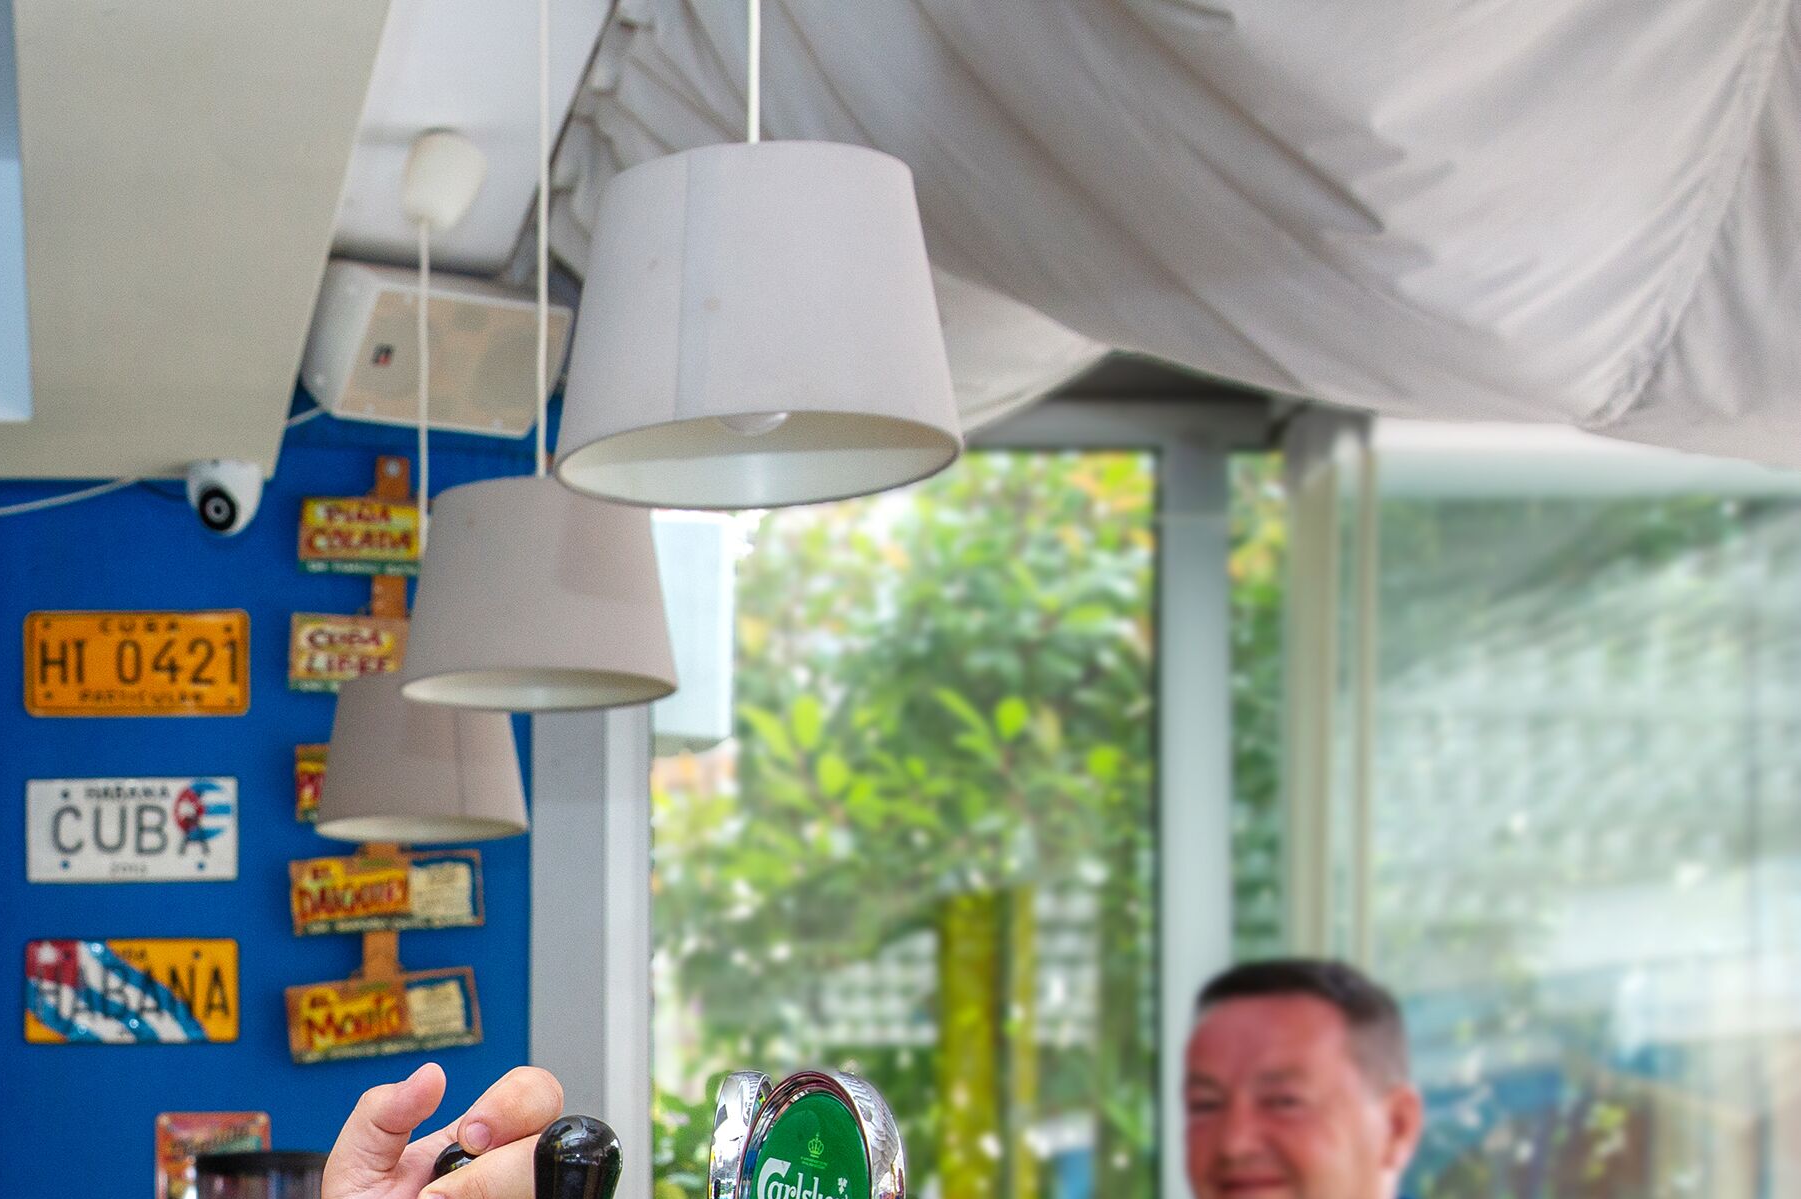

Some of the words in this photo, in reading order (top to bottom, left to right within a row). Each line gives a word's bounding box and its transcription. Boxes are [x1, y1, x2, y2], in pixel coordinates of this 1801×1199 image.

[115, 637, 239, 685] 0421
[52, 804, 211, 857] CUBA
[36, 964, 230, 1021] HABANA
